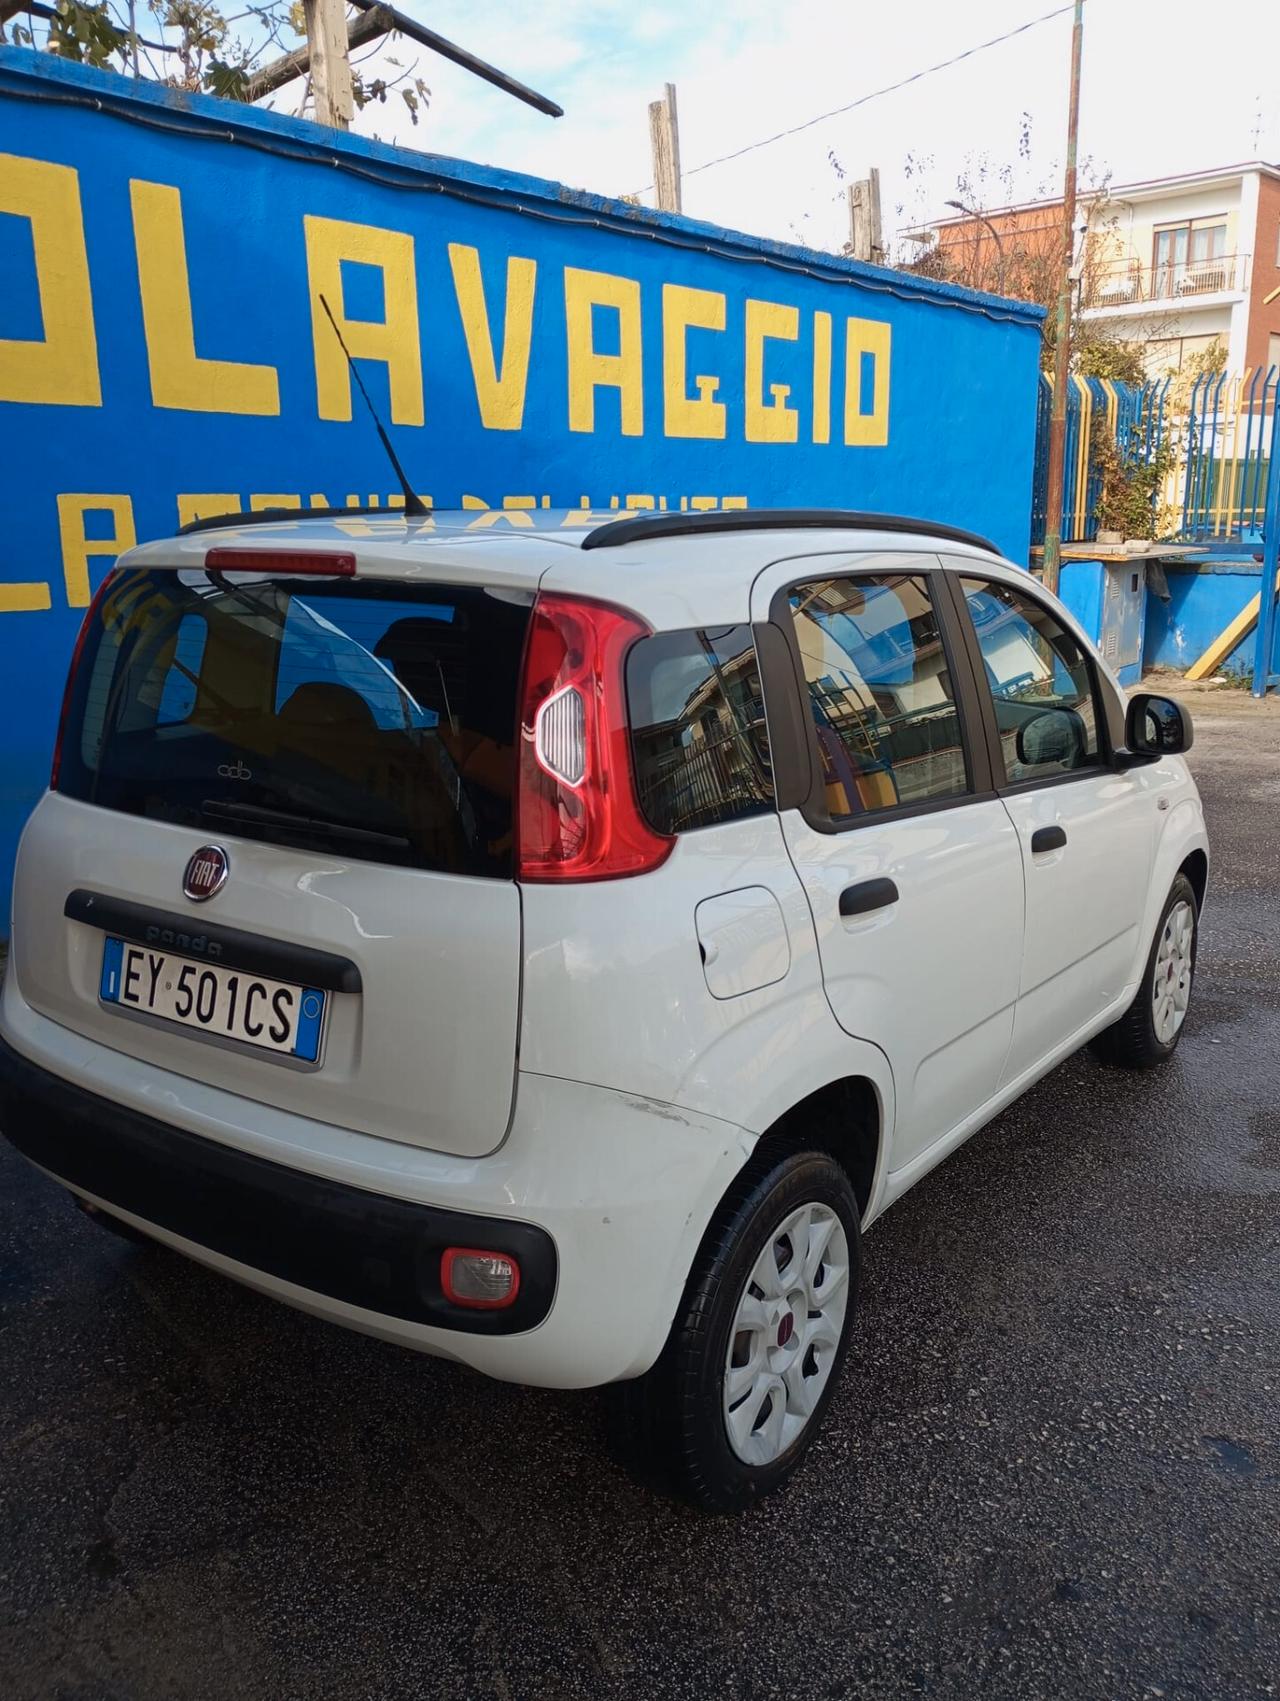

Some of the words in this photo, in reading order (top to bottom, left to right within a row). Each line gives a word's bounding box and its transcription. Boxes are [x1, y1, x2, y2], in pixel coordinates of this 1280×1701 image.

[189, 858, 220, 887] FIAT
[144, 925, 224, 957] panda
[123, 949, 165, 1008] EY
[175, 964, 293, 1044] 501CS
